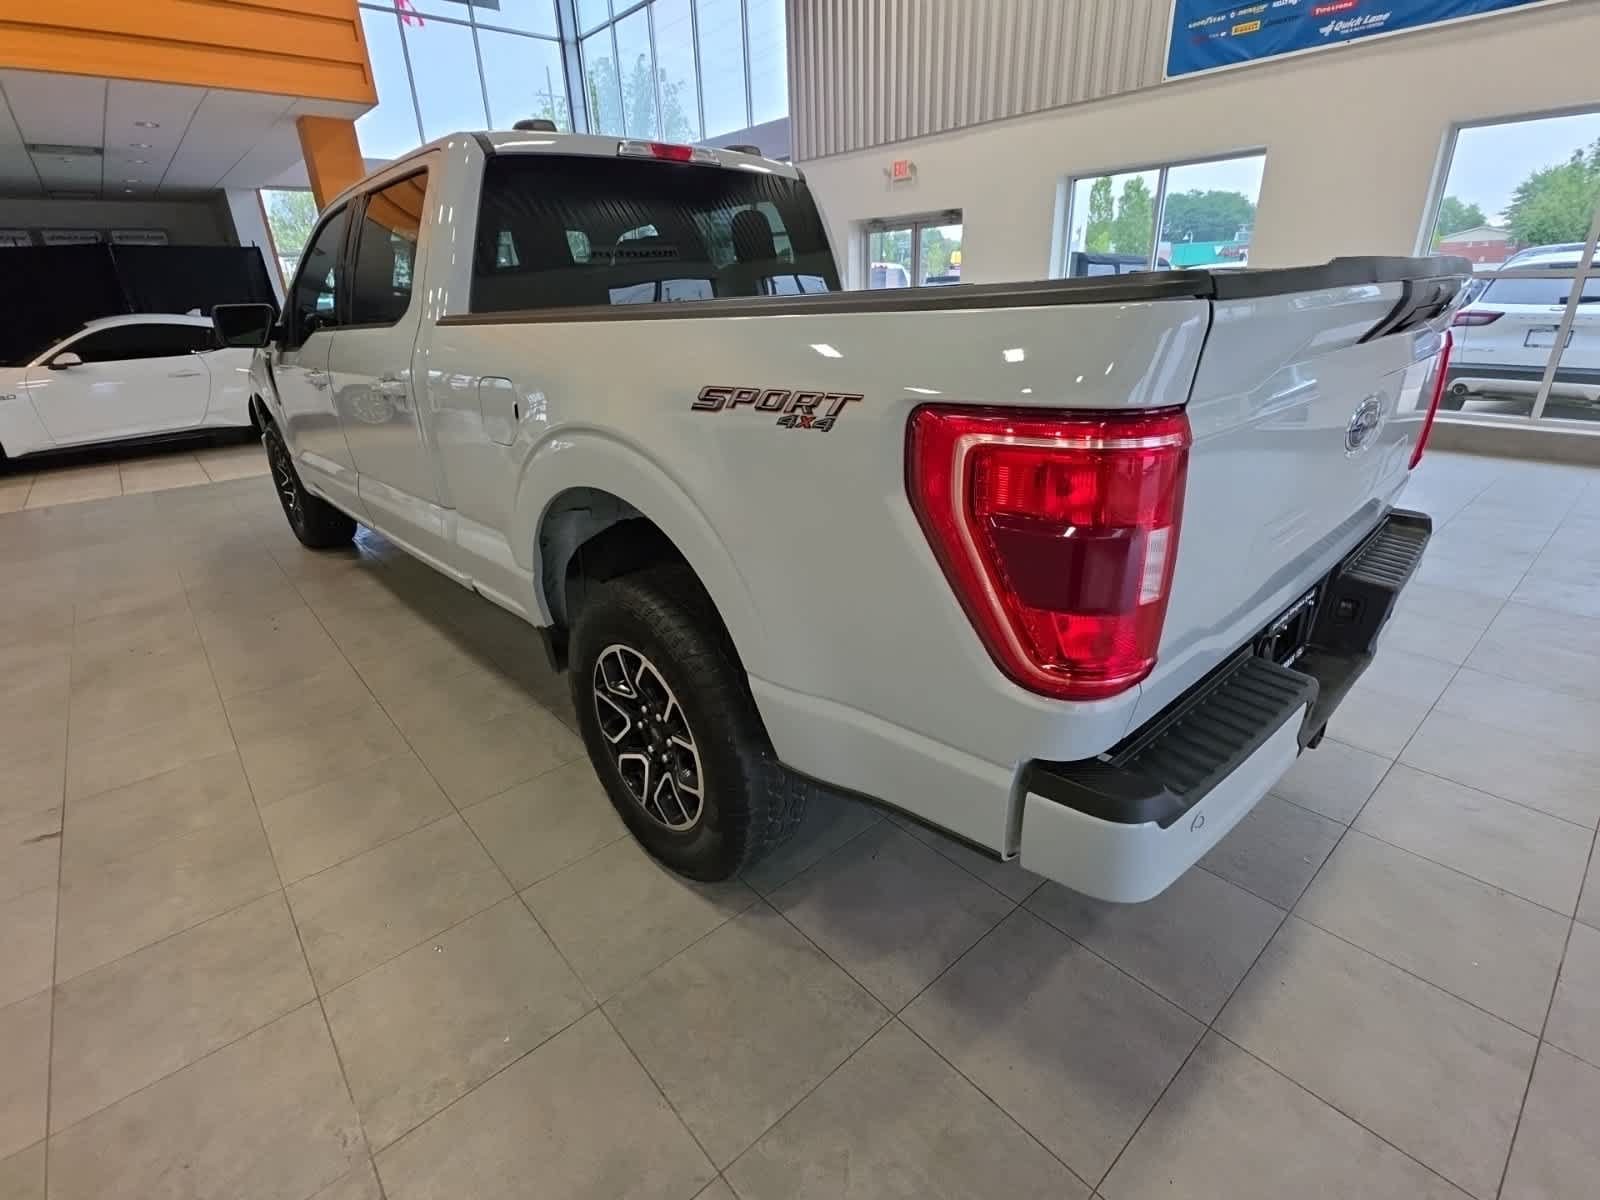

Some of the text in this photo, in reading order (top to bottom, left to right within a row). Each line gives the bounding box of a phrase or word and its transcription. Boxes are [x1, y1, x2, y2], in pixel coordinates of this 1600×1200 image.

[1334, 16, 1363, 31] Quick
[1362, 12, 1391, 25] Lane
[691, 385, 865, 417] SPORT
